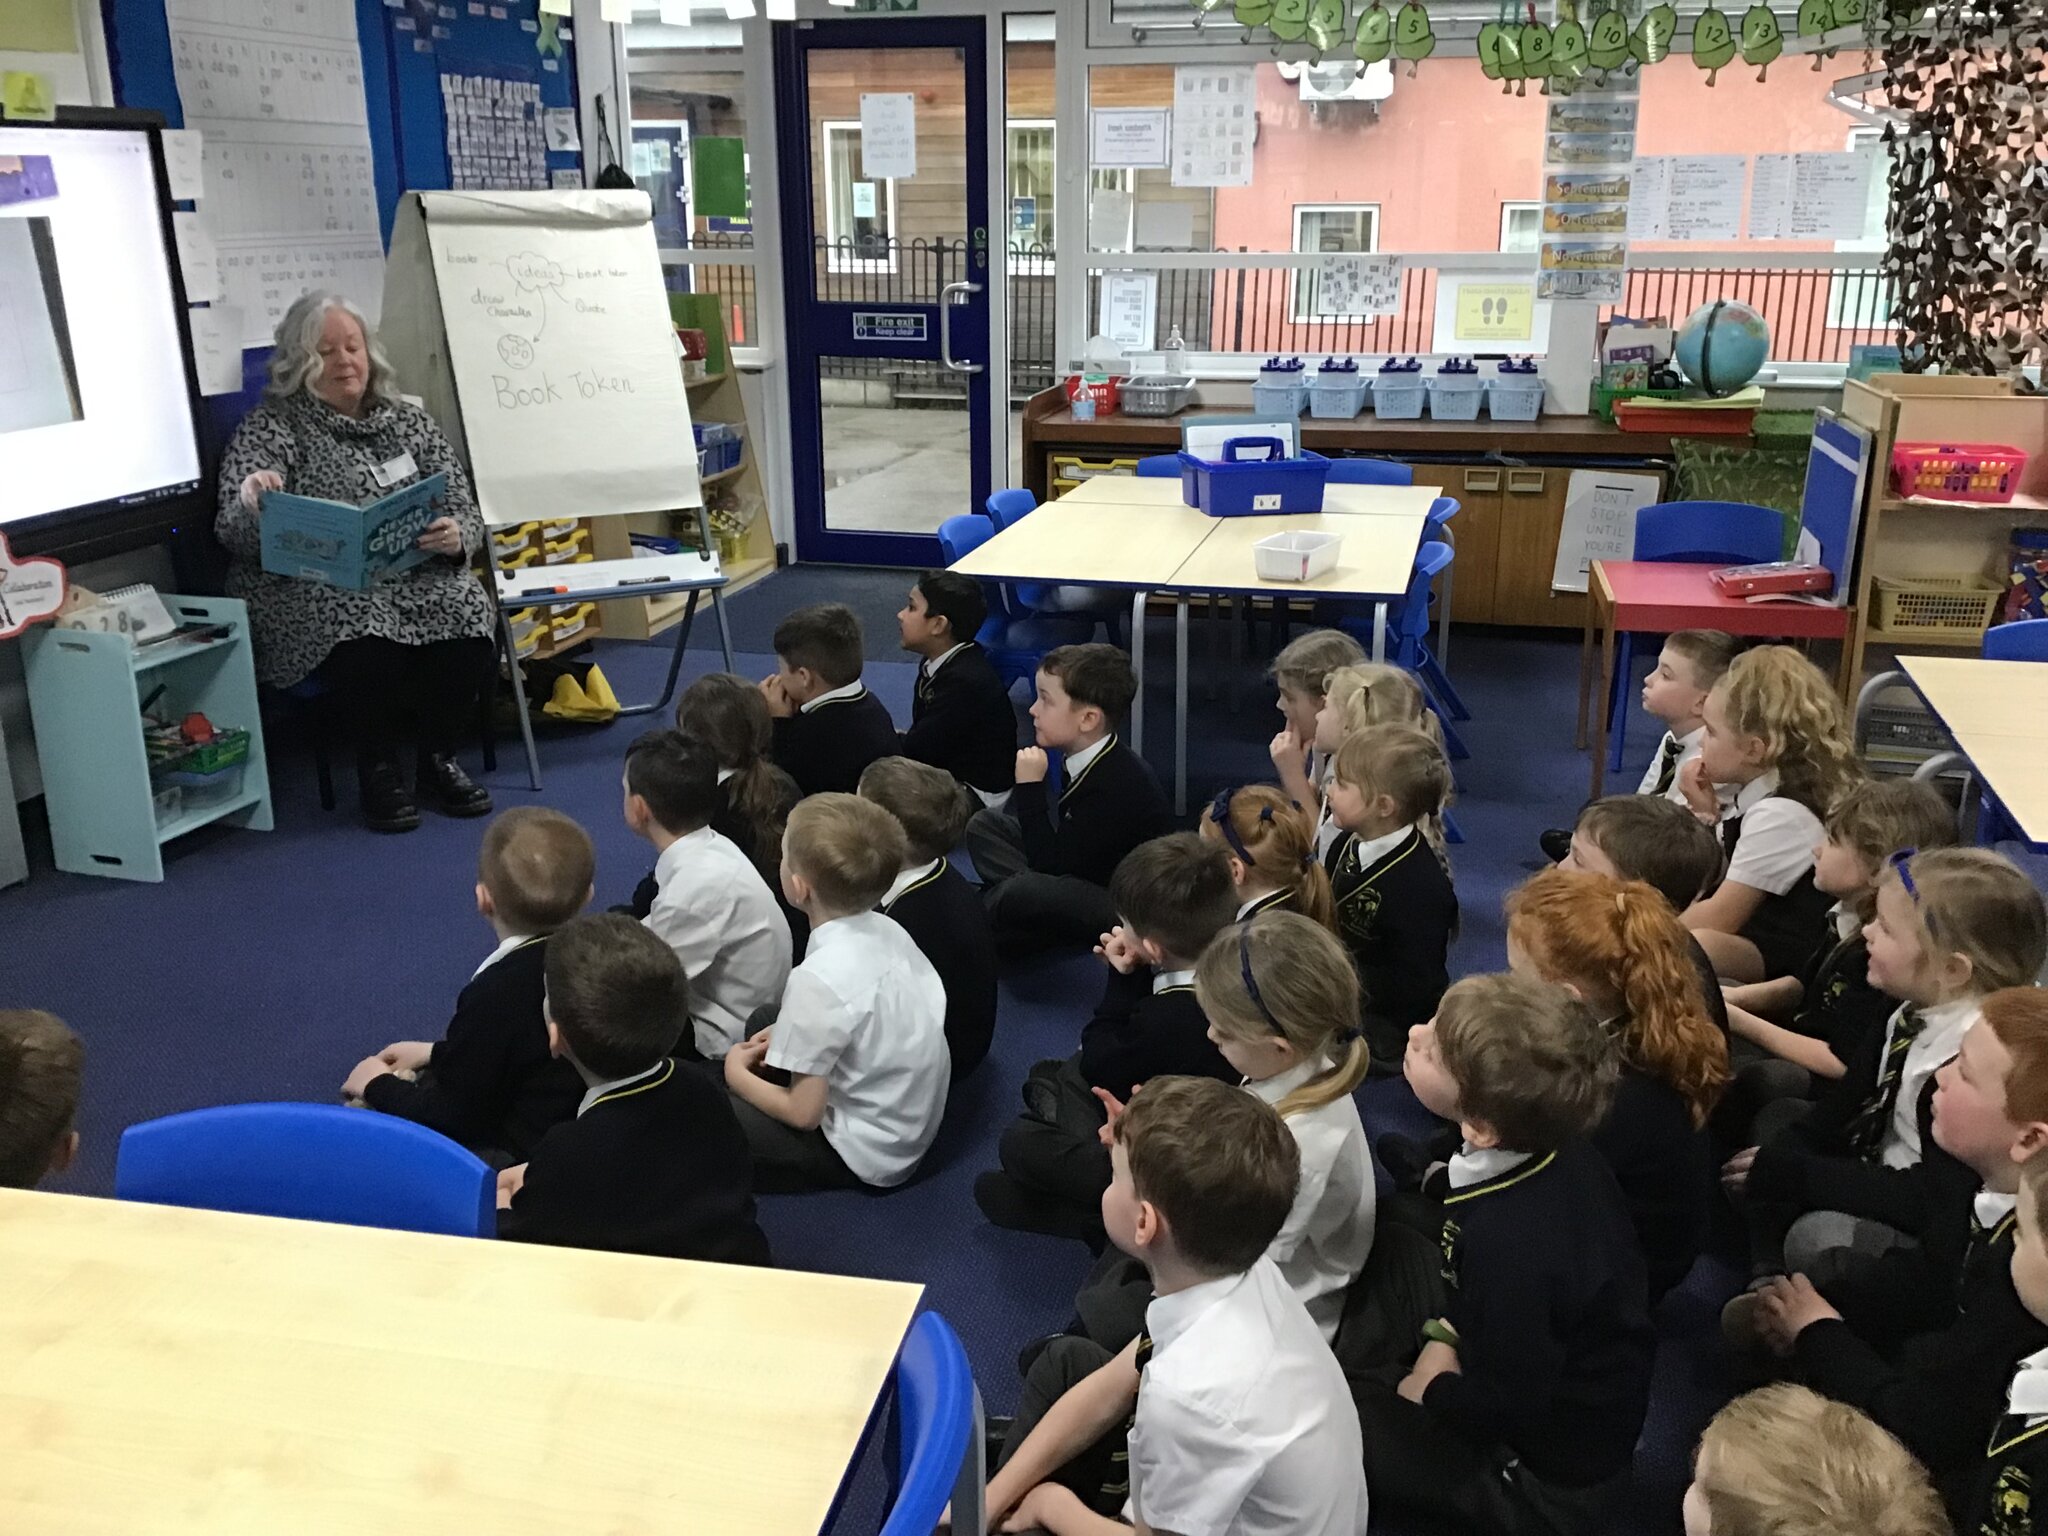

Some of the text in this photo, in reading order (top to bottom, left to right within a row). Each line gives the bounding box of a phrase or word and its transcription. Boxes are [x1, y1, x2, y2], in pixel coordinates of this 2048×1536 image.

[1286, 0, 1299, 14] 2
[1843, 1, 1862, 15] 15
[1324, 11, 1334, 24] 3
[1809, 12, 1827, 28] 14
[1370, 23, 1379, 35] 4
[1408, 19, 1419, 34] 5
[1754, 22, 1770, 39] 13
[1603, 26, 1621, 44] 10
[1705, 25, 1724, 44] 12
[1533, 37, 1543, 52] 8
[1566, 36, 1575, 51] 9
[1556, 183, 1619, 198] September
[1560, 213, 1609, 225] October
[1552, 250, 1614, 262] November
[517, 264, 555, 279] ideas
[470, 288, 505, 304] draw
[875, 316, 914, 326] Fire exit
[875, 328, 914, 337] Keep clear
[492, 368, 635, 409] Book Token
[1591, 507, 1628, 521] STOP
[379, 508, 423, 536] NEVER
[369, 513, 432, 552] GROW
[1586, 524, 1625, 538] UNTIL
[389, 535, 412, 555] UP
